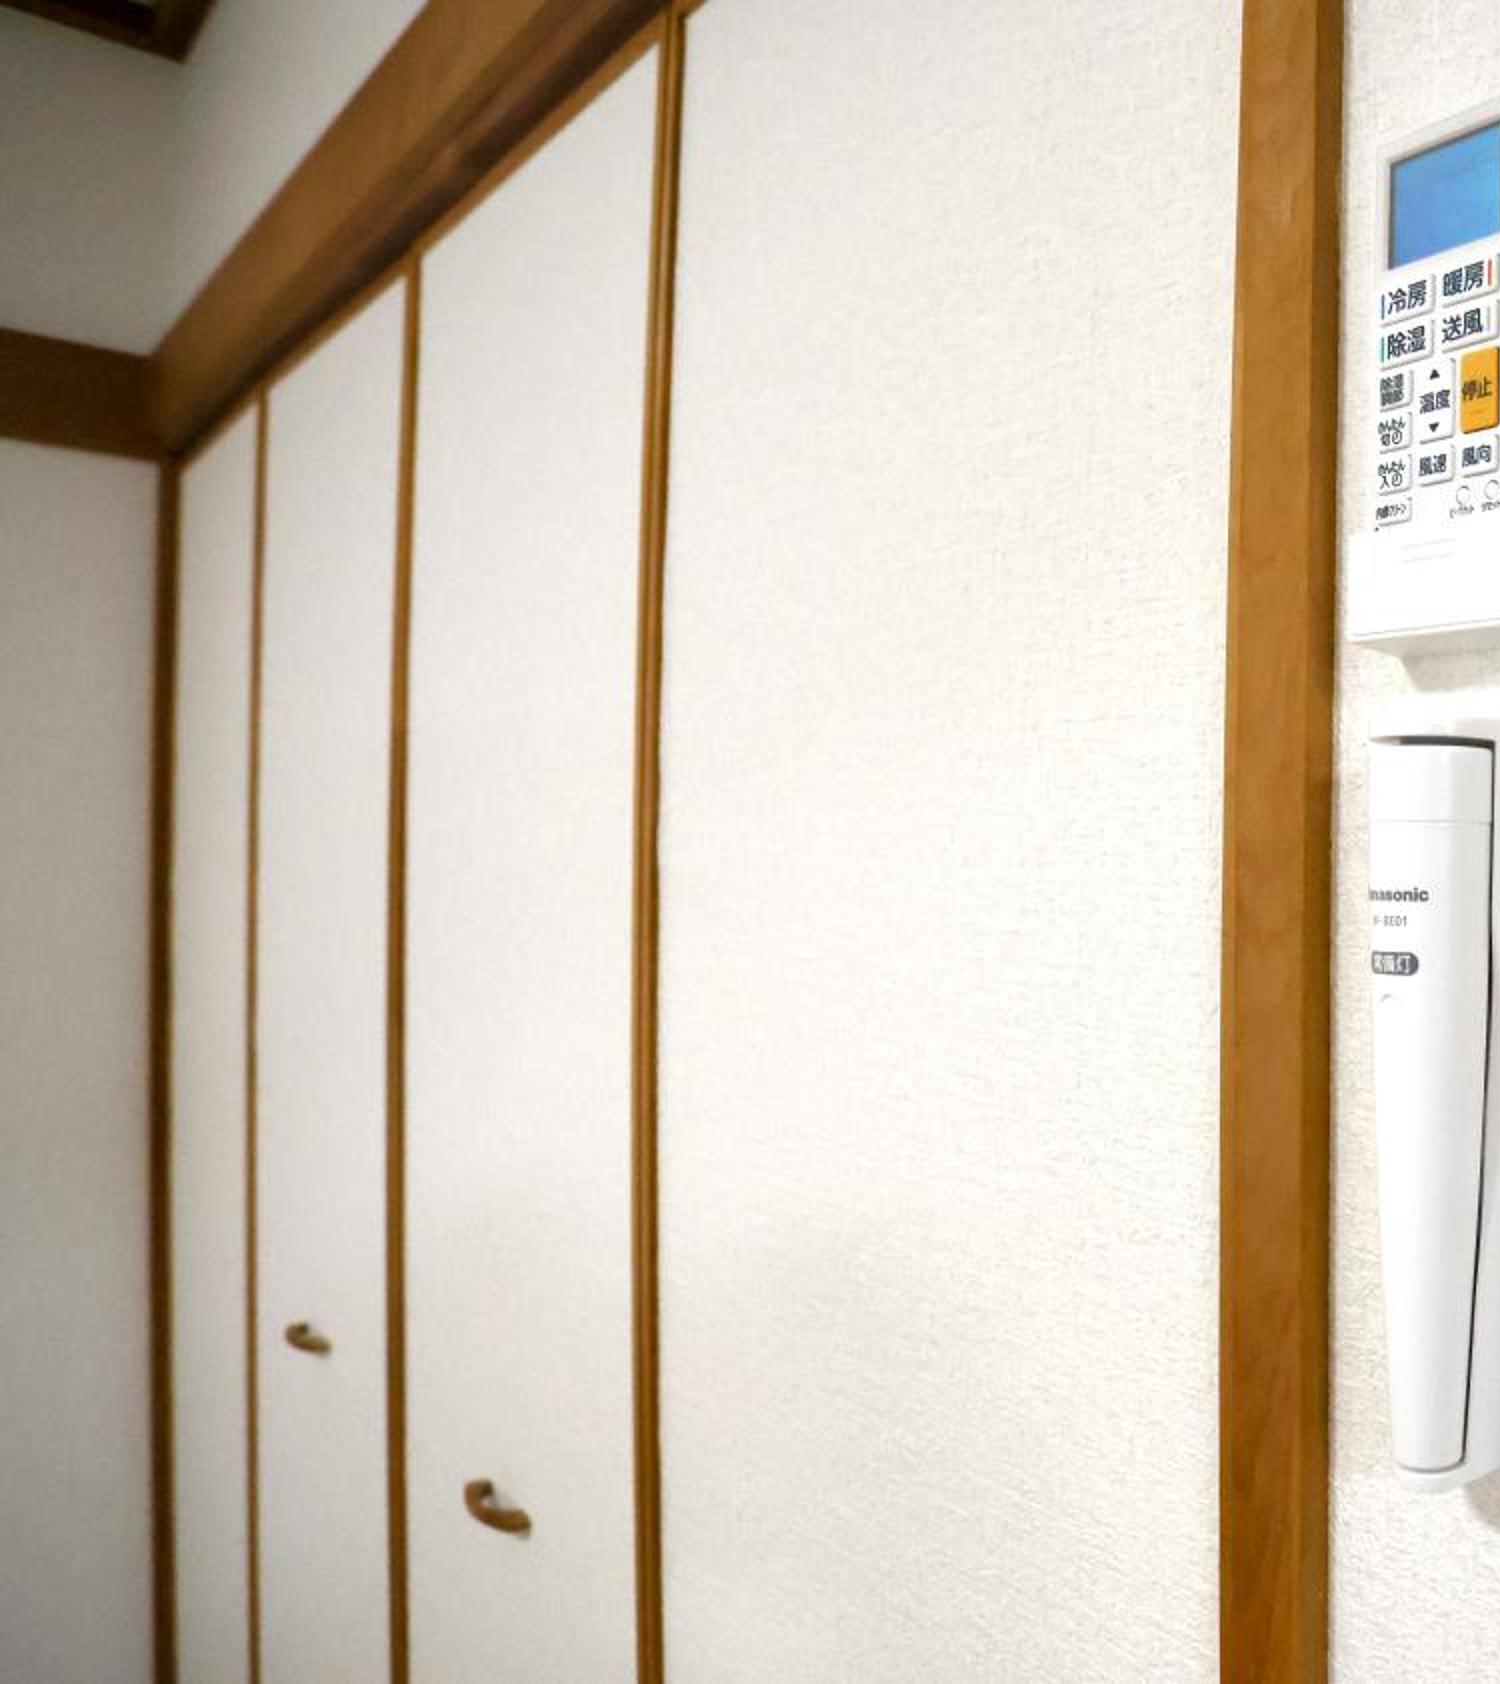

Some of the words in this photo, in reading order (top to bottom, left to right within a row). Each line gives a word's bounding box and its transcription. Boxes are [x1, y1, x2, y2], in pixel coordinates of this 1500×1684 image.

[1443, 260, 1484, 296] 暖房
[1387, 279, 1427, 315] 冷房
[1441, 308, 1483, 343] 送風
[1387, 325, 1426, 360] 除湿
[1461, 376, 1493, 401] 停止
[1420, 389, 1450, 414] 温度
[1419, 453, 1447, 477] 風速
[1462, 445, 1491, 468] 風向
[1368, 887, 1429, 902] nasonic
